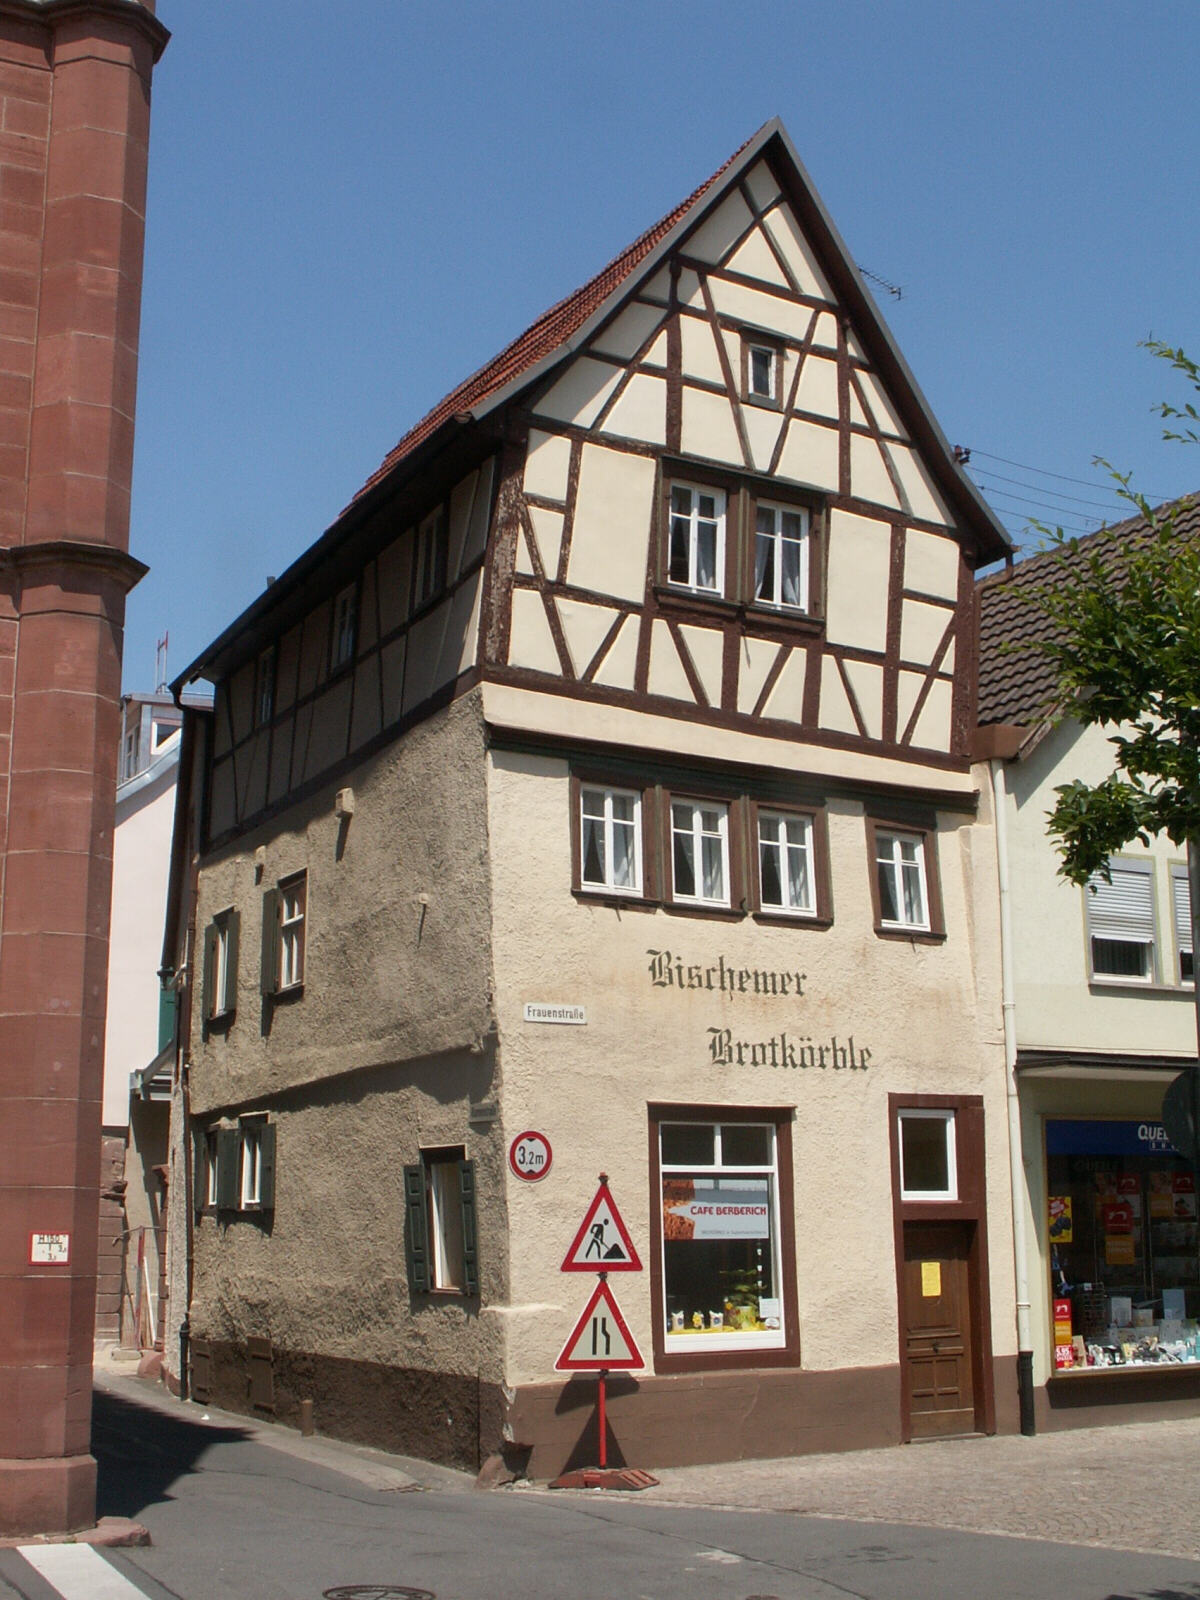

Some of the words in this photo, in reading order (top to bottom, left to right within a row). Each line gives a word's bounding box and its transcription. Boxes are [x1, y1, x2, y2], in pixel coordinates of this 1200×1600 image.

[646, 949, 807, 998] Bischemer
[527, 1005, 584, 1020] Frauenstraße
[706, 1027, 873, 1071] Brotkörble
[690, 1206, 714, 1216] CAFE
[715, 1206, 767, 1217] BERBERICH
